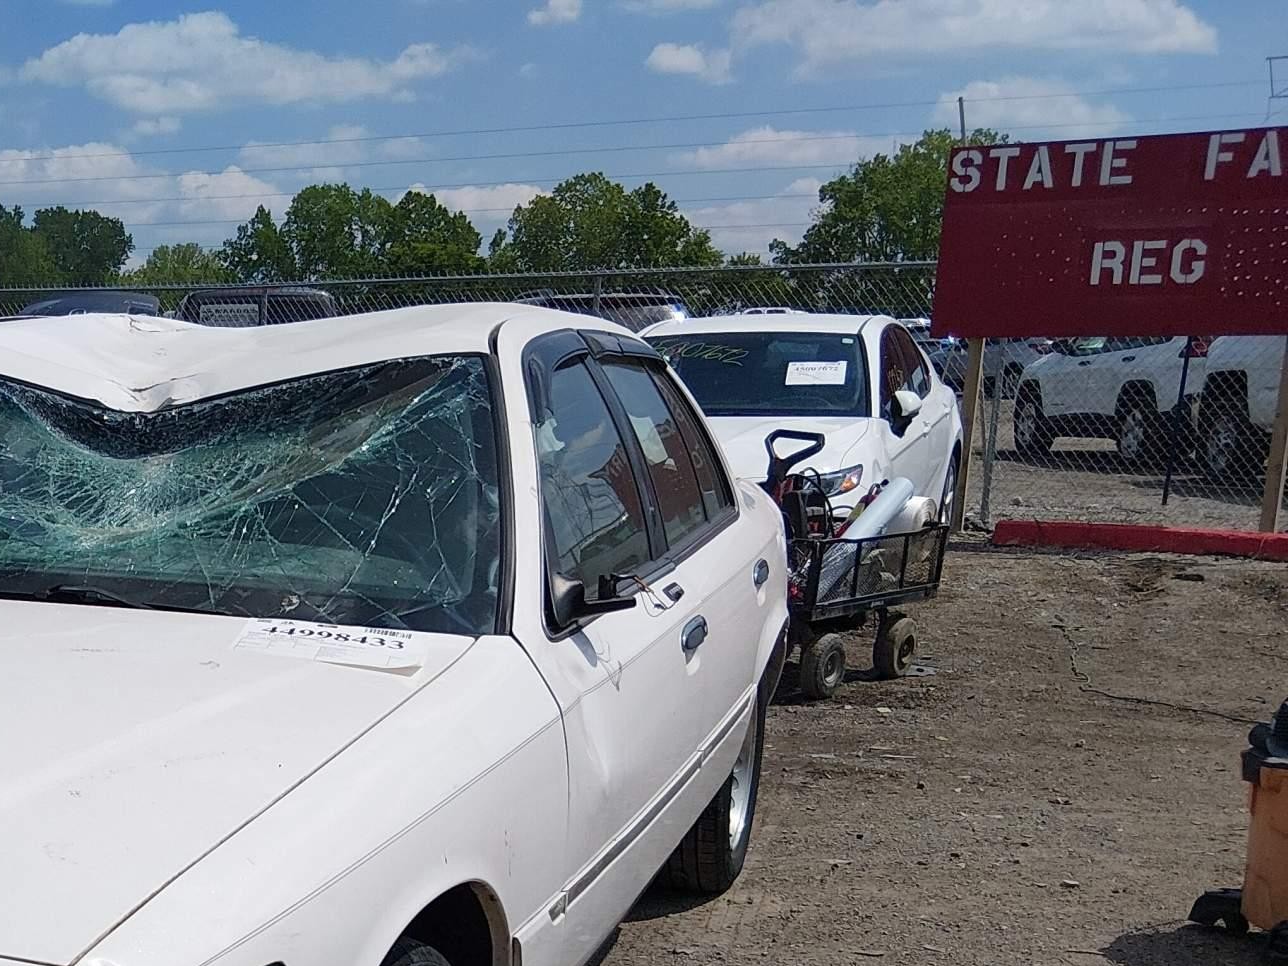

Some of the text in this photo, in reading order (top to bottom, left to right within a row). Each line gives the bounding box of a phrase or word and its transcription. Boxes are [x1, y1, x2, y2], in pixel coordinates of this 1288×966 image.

[950, 130, 1283, 193] STATE FA
[1089, 239, 1208, 286] REG
[262, 626, 405, 650] 44998433
